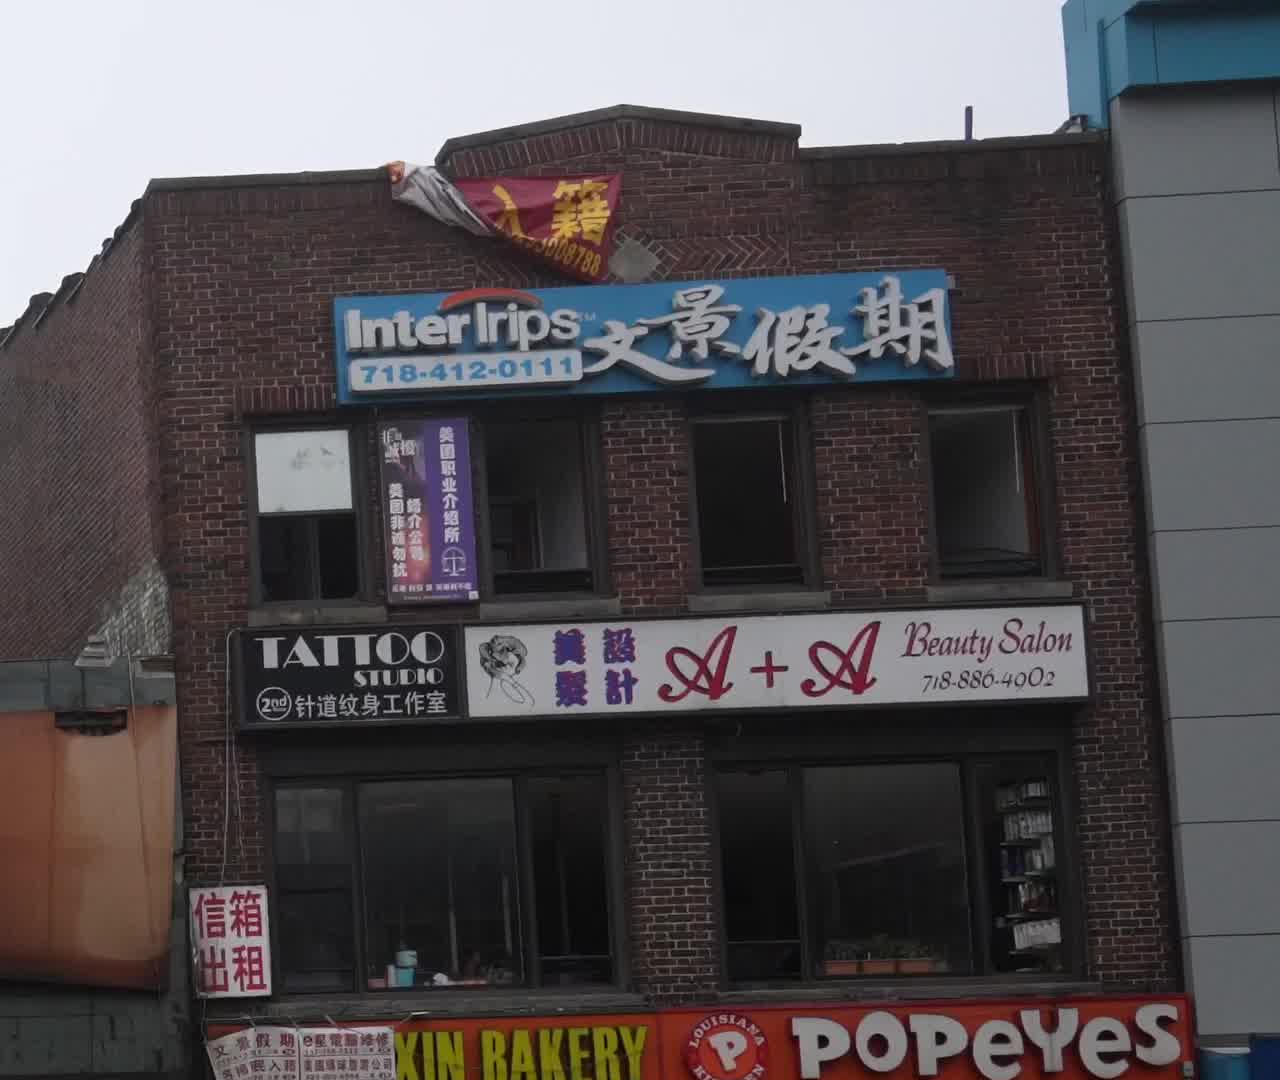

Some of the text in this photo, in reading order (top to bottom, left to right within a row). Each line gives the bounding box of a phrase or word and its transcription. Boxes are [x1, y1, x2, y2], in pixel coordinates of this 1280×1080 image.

[582, 274, 954, 385] 文景假期
[360, 356, 575, 385] 718-412-0111
[255, 631, 445, 669] TATTOO
[901, 617, 1073, 663] Beauty Salon
[353, 669, 444, 687] STUDIO
[922, 666, 1055, 693] 718-886-4902
[262, 695, 288, 711] 2nd
[294, 691, 447, 718] 针道纹身工作室
[194, 890, 263, 939] 信箱
[199, 944, 267, 993] 出租
[689, 1014, 765, 1049] LOUISIANA
